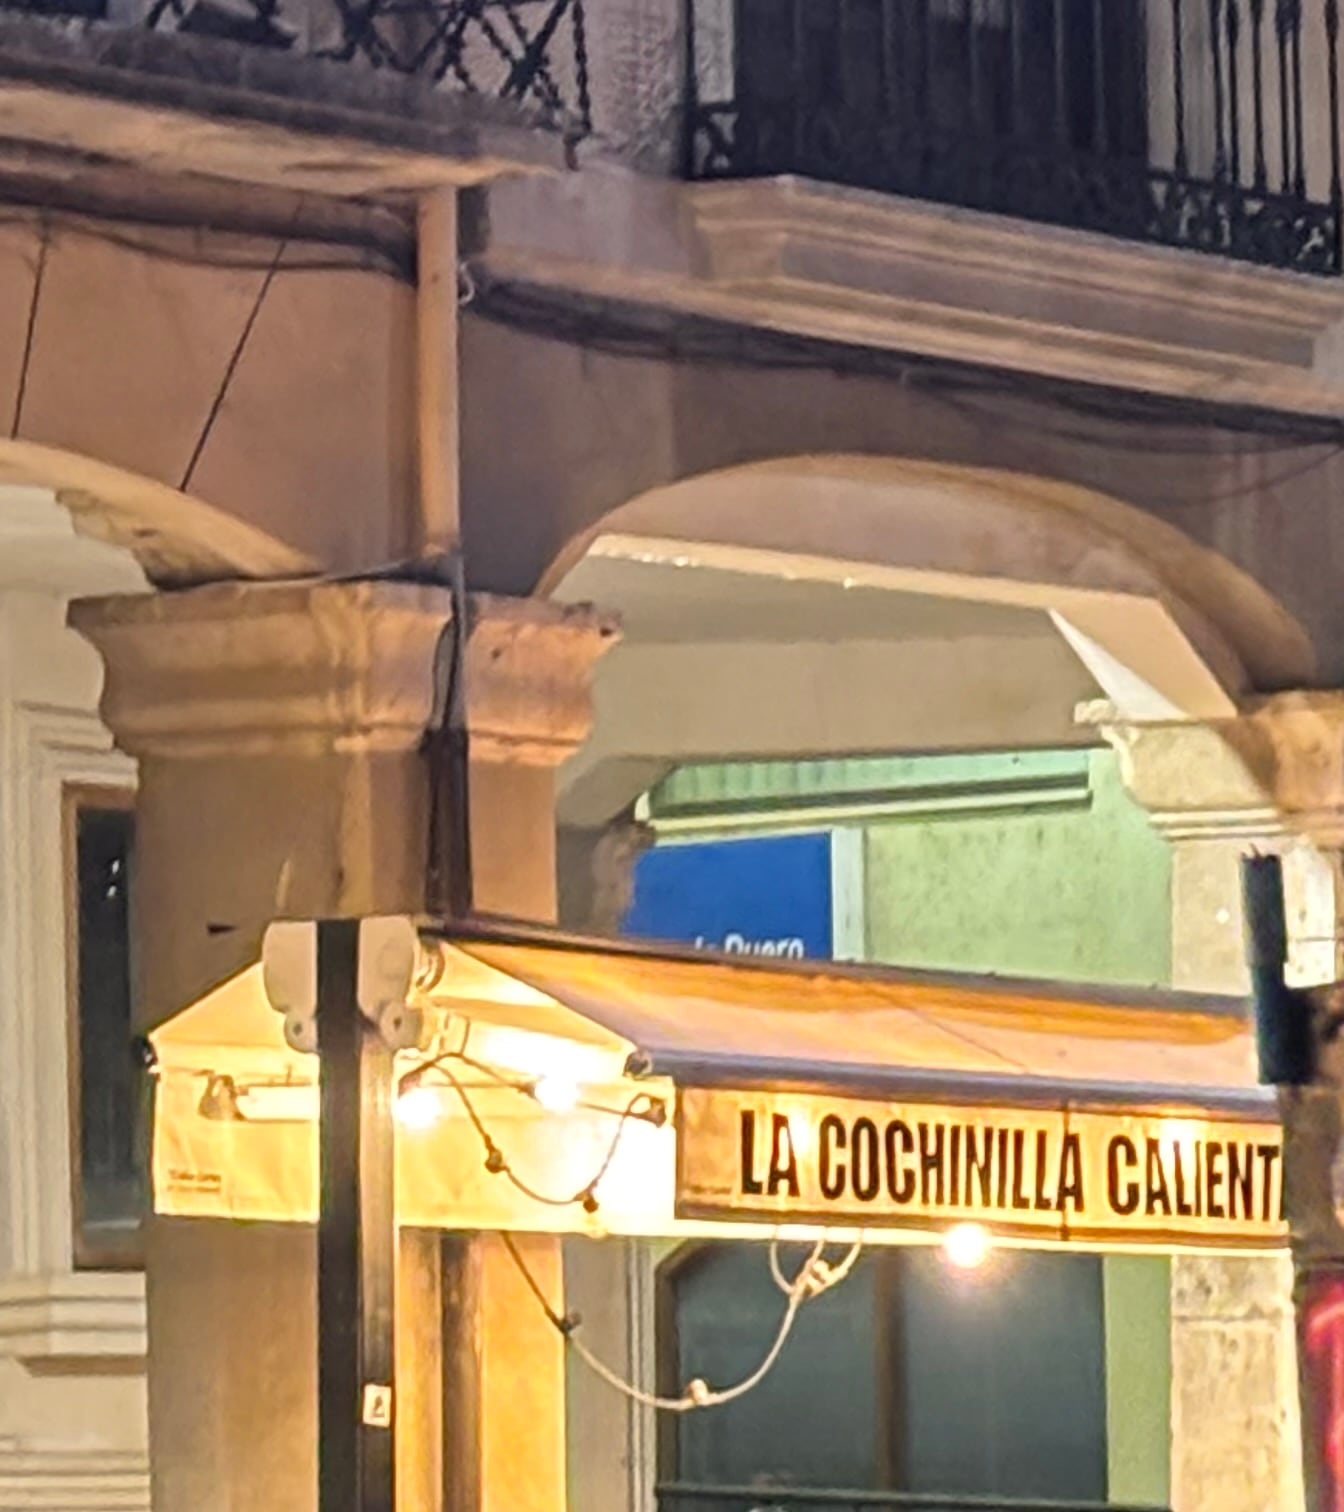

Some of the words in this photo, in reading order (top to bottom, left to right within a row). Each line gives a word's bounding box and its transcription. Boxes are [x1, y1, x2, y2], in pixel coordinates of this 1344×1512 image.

[740, 1109, 801, 1198] LA
[819, 1113, 1085, 1213] COCHINILLA
[1107, 1134, 1286, 1222] CALIENT
